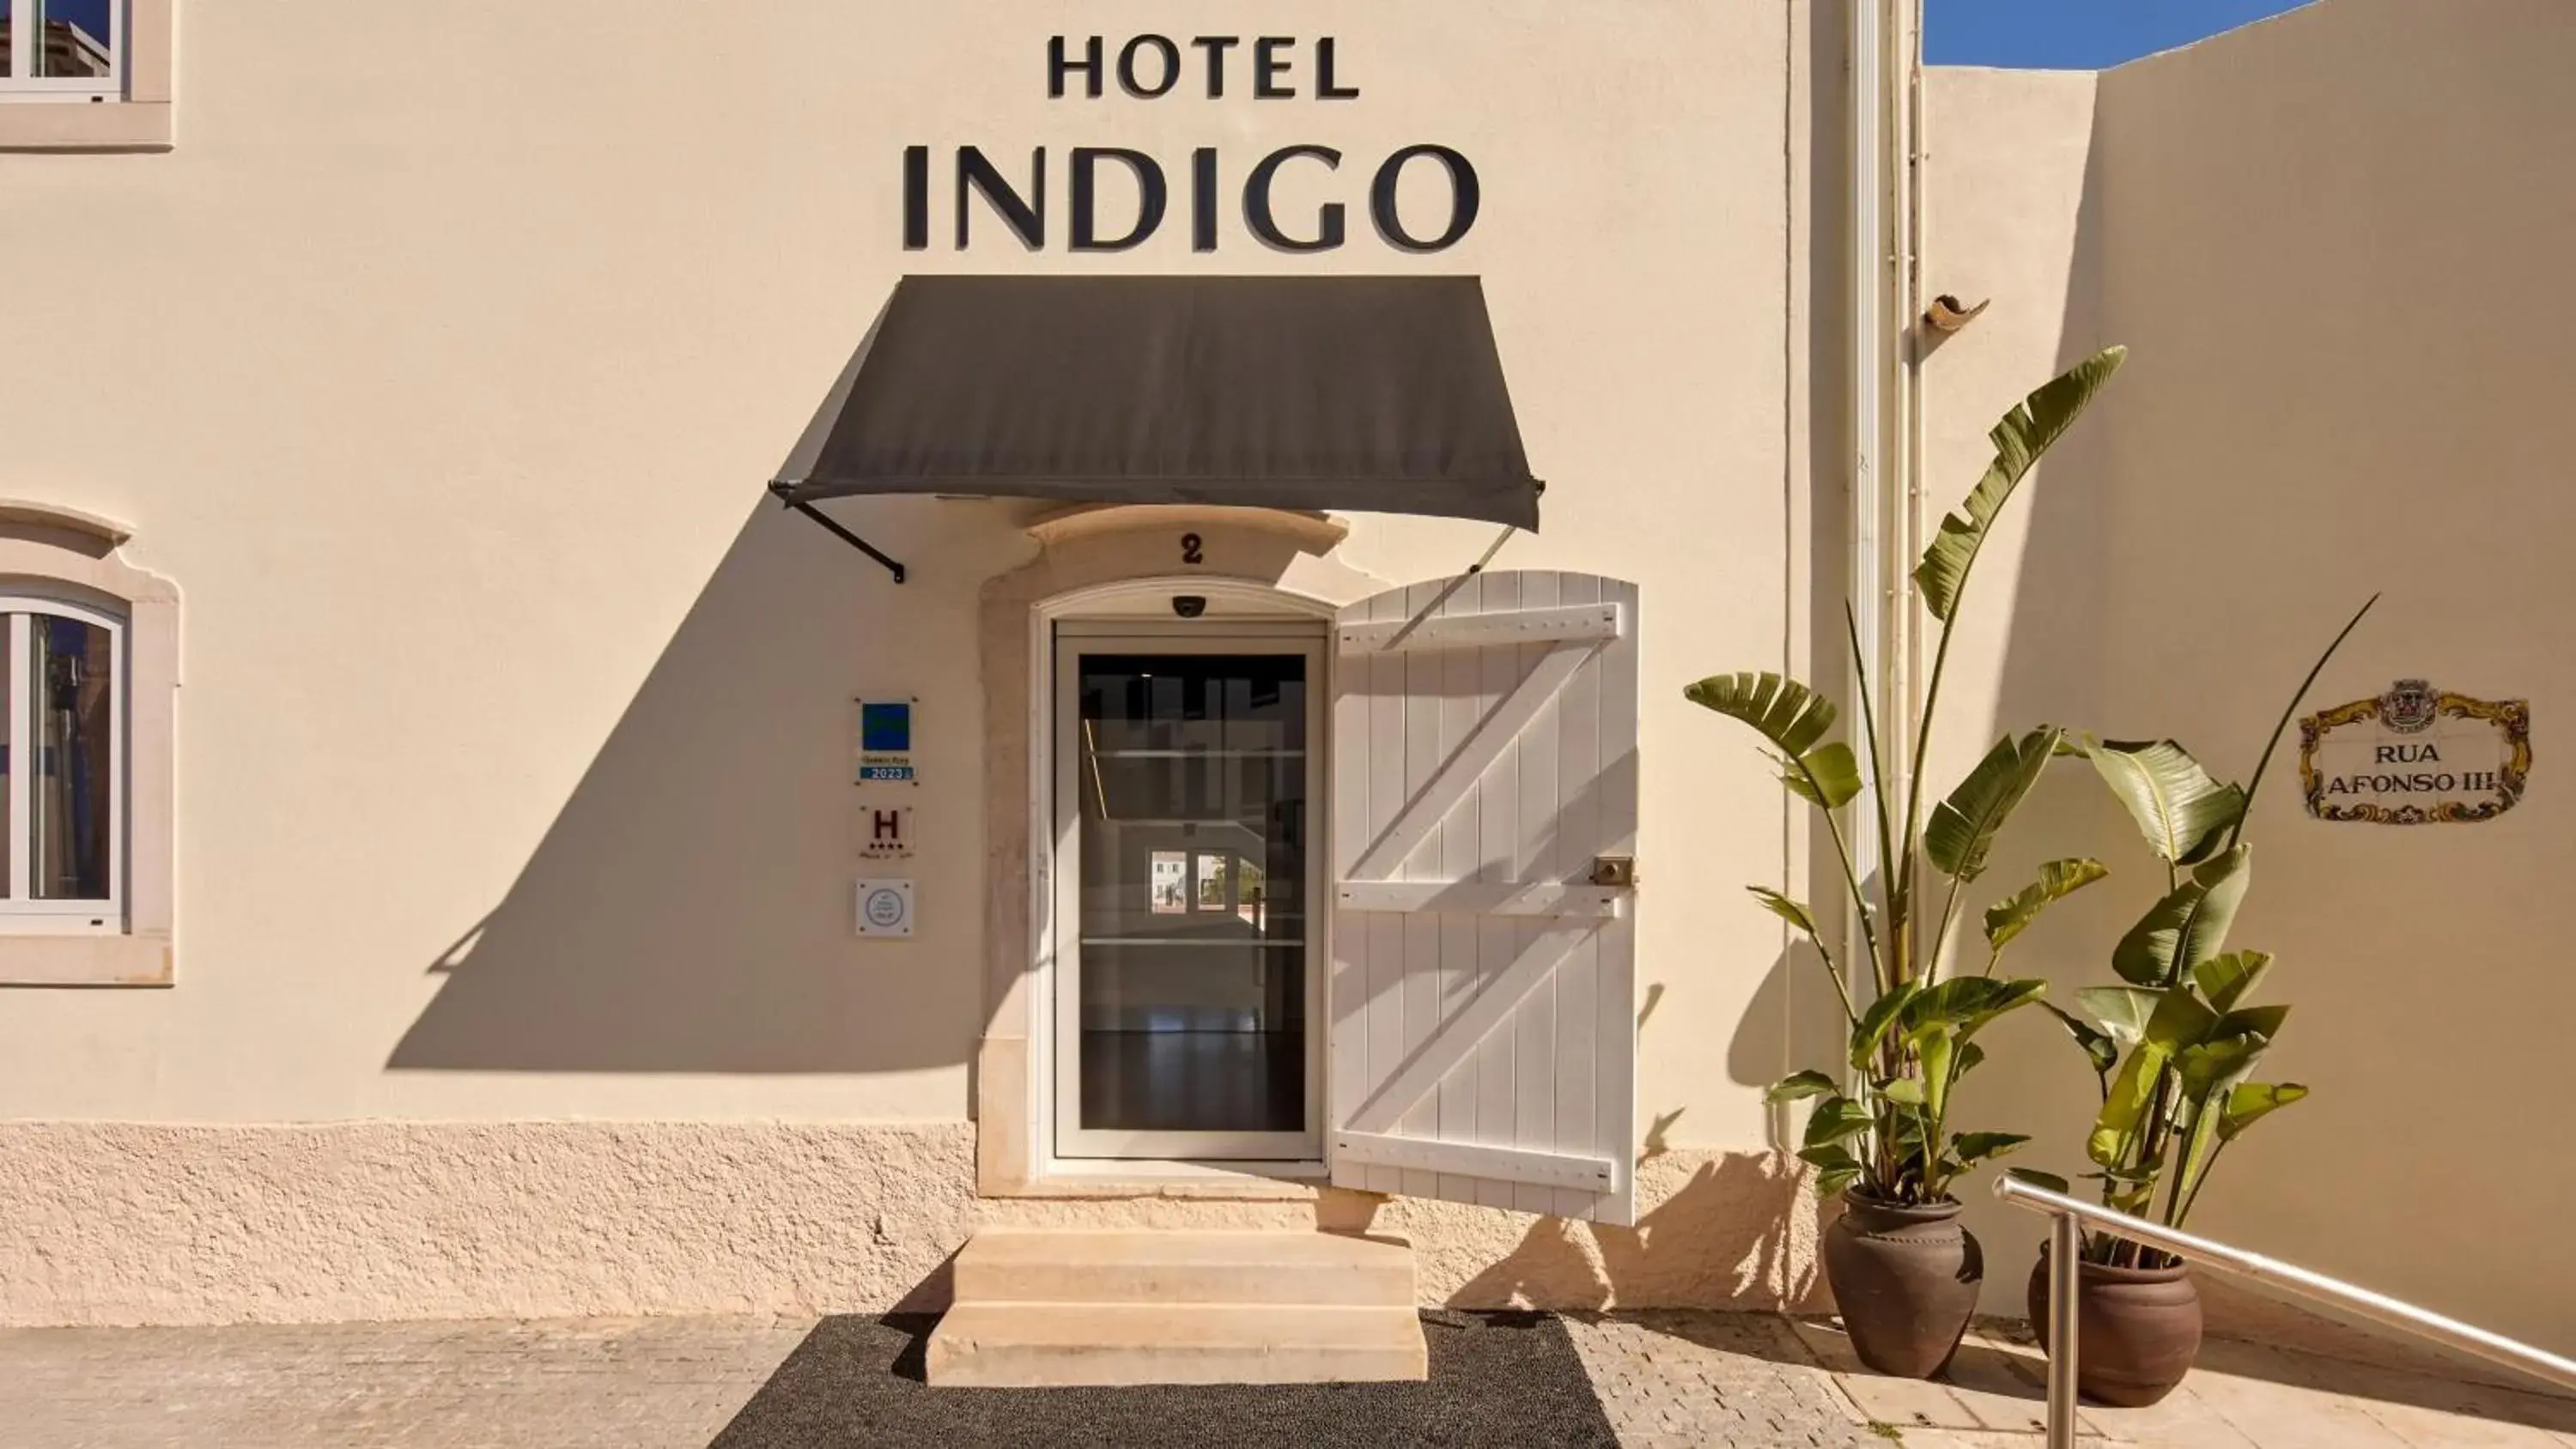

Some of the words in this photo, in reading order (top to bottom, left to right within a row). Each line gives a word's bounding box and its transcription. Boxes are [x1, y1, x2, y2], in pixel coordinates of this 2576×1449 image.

[1048, 33, 1359, 100] HOTEL
[903, 143, 1479, 254] INDIGO
[1181, 532, 1203, 564] 2
[2375, 743, 2441, 764] RUA
[2327, 773, 2455, 794] AFONSO
[2463, 772, 2495, 791] III
[874, 809, 898, 840] H
